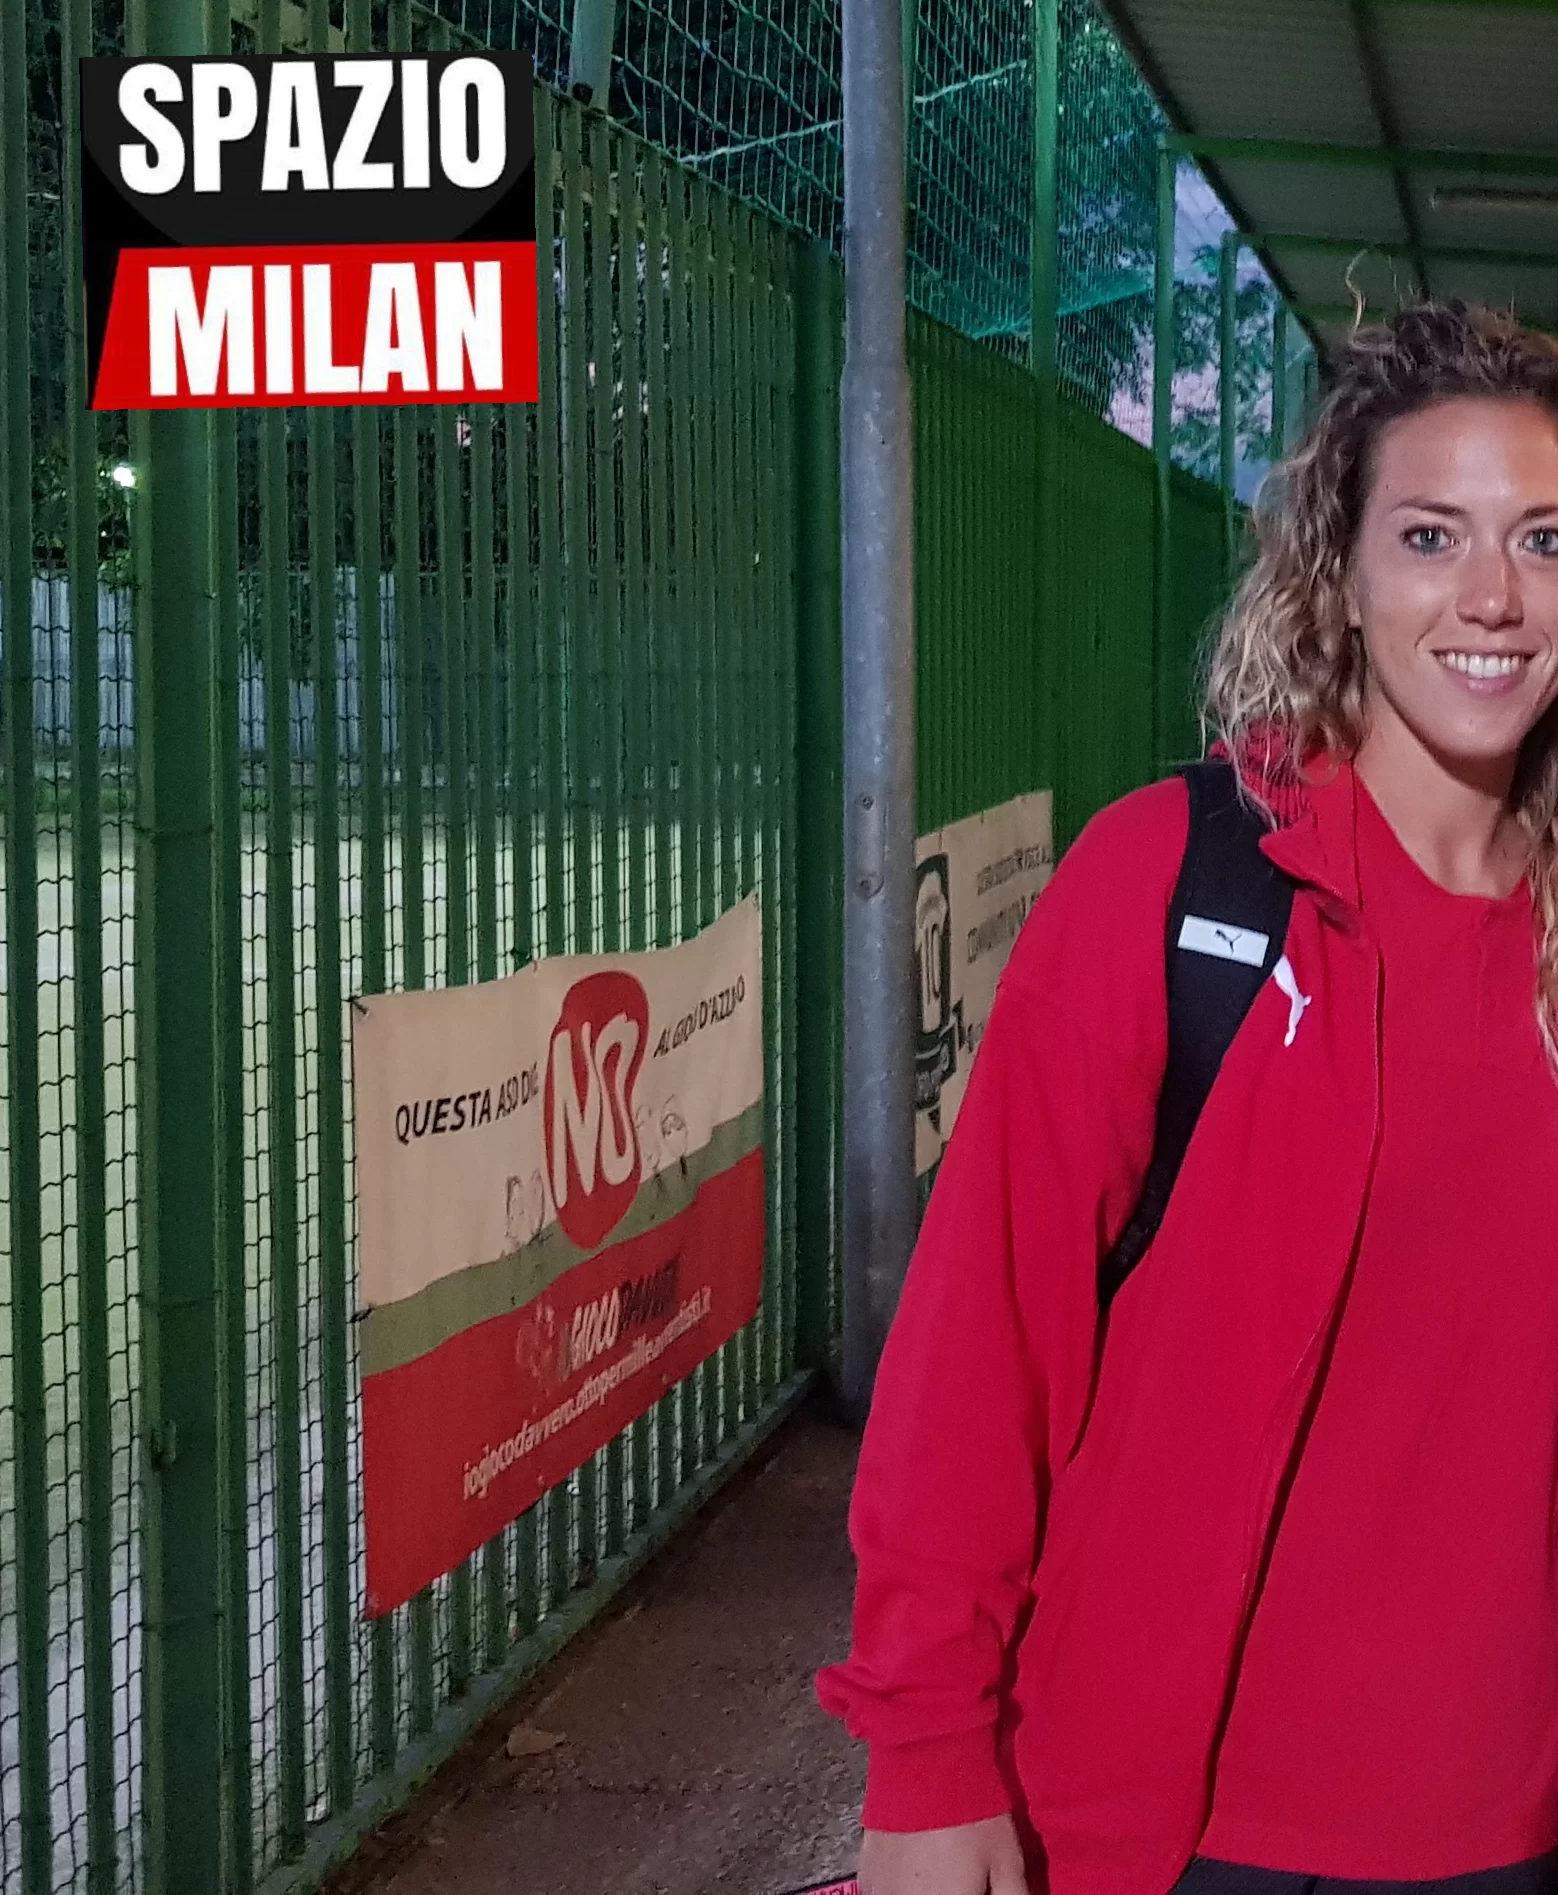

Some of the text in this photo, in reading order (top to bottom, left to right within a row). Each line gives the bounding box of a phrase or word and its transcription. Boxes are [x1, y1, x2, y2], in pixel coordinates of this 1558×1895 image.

[653, 1027, 671, 1059] AL
[395, 1088, 492, 1146] QUESTA
[552, 1011, 640, 1210] NO
